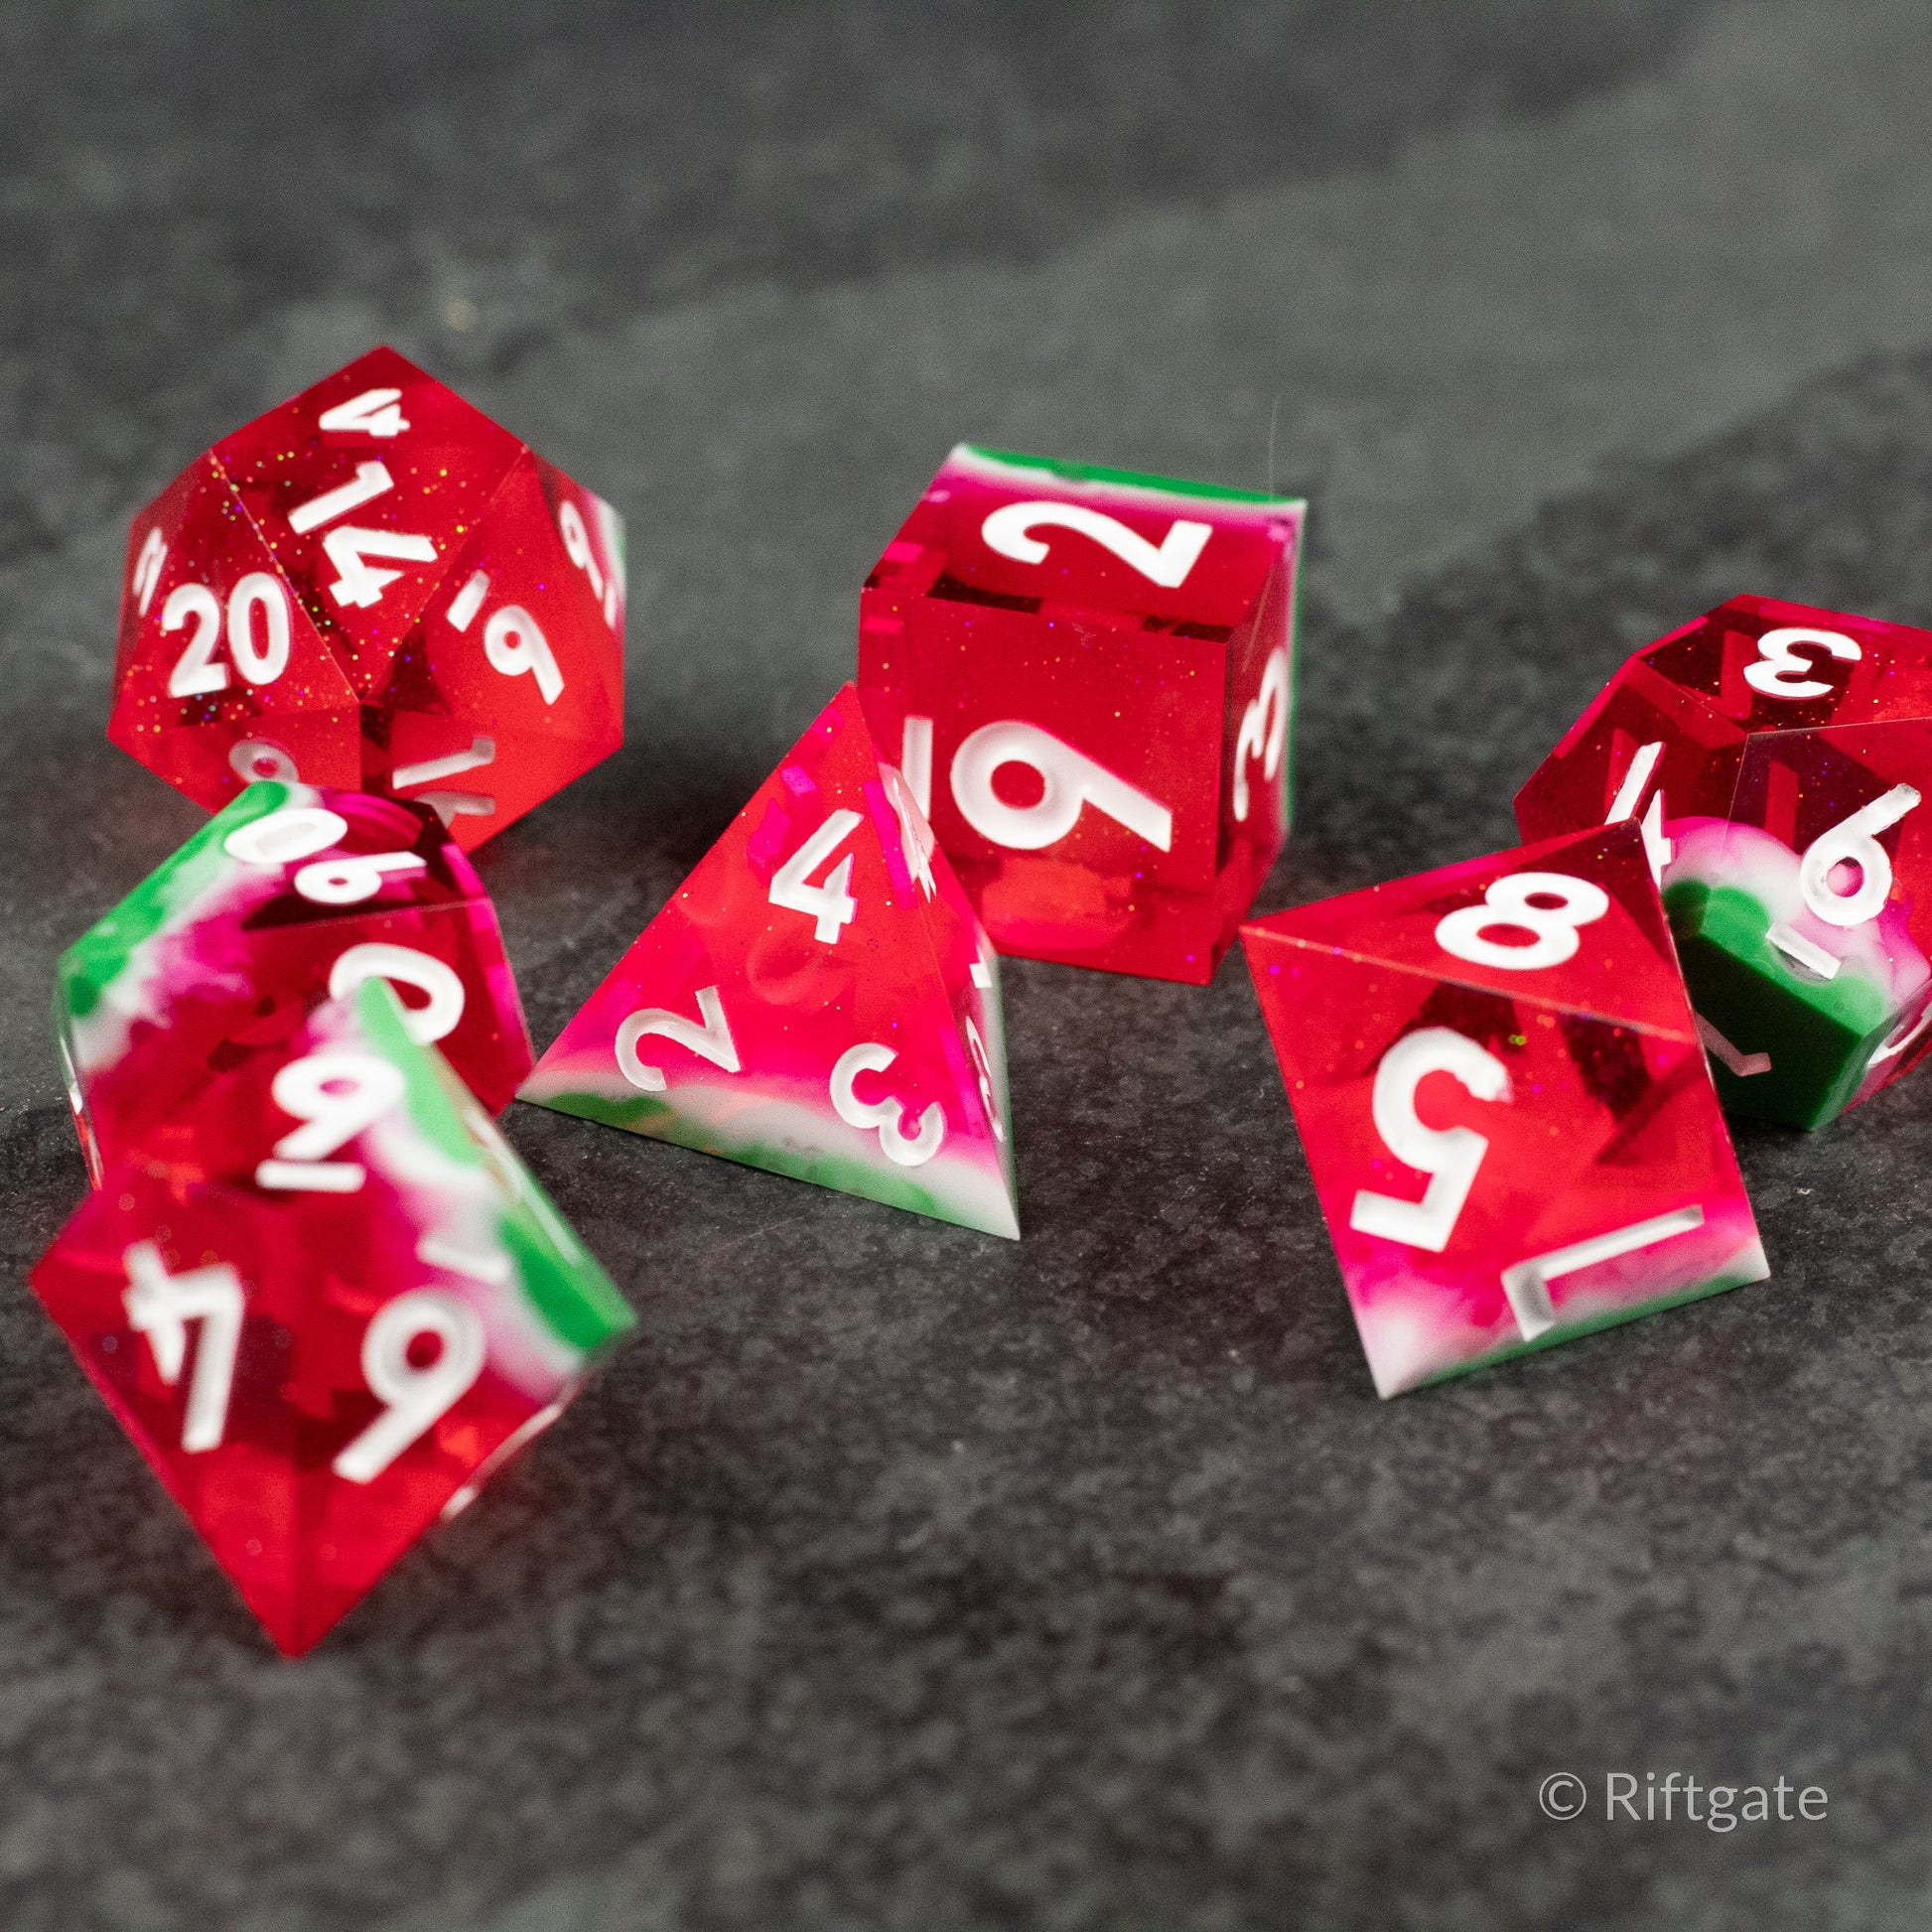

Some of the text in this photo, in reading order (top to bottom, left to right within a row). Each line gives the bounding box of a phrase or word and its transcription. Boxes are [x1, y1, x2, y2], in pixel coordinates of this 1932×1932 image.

[319, 388, 410, 437] 4
[288, 462, 438, 608] 14
[982, 501, 1211, 588] 2
[162, 572, 290, 698] 20
[1743, 627, 1862, 697] 3
[1233, 647, 1287, 821] 3
[769, 809, 864, 945] 4
[1435, 872, 1609, 970] 8
[615, 986, 741, 1092] 2
[830, 1042, 946, 1167] 3
[1350, 1027, 1513, 1253] 5
[121, 1241, 248, 1453] 4
